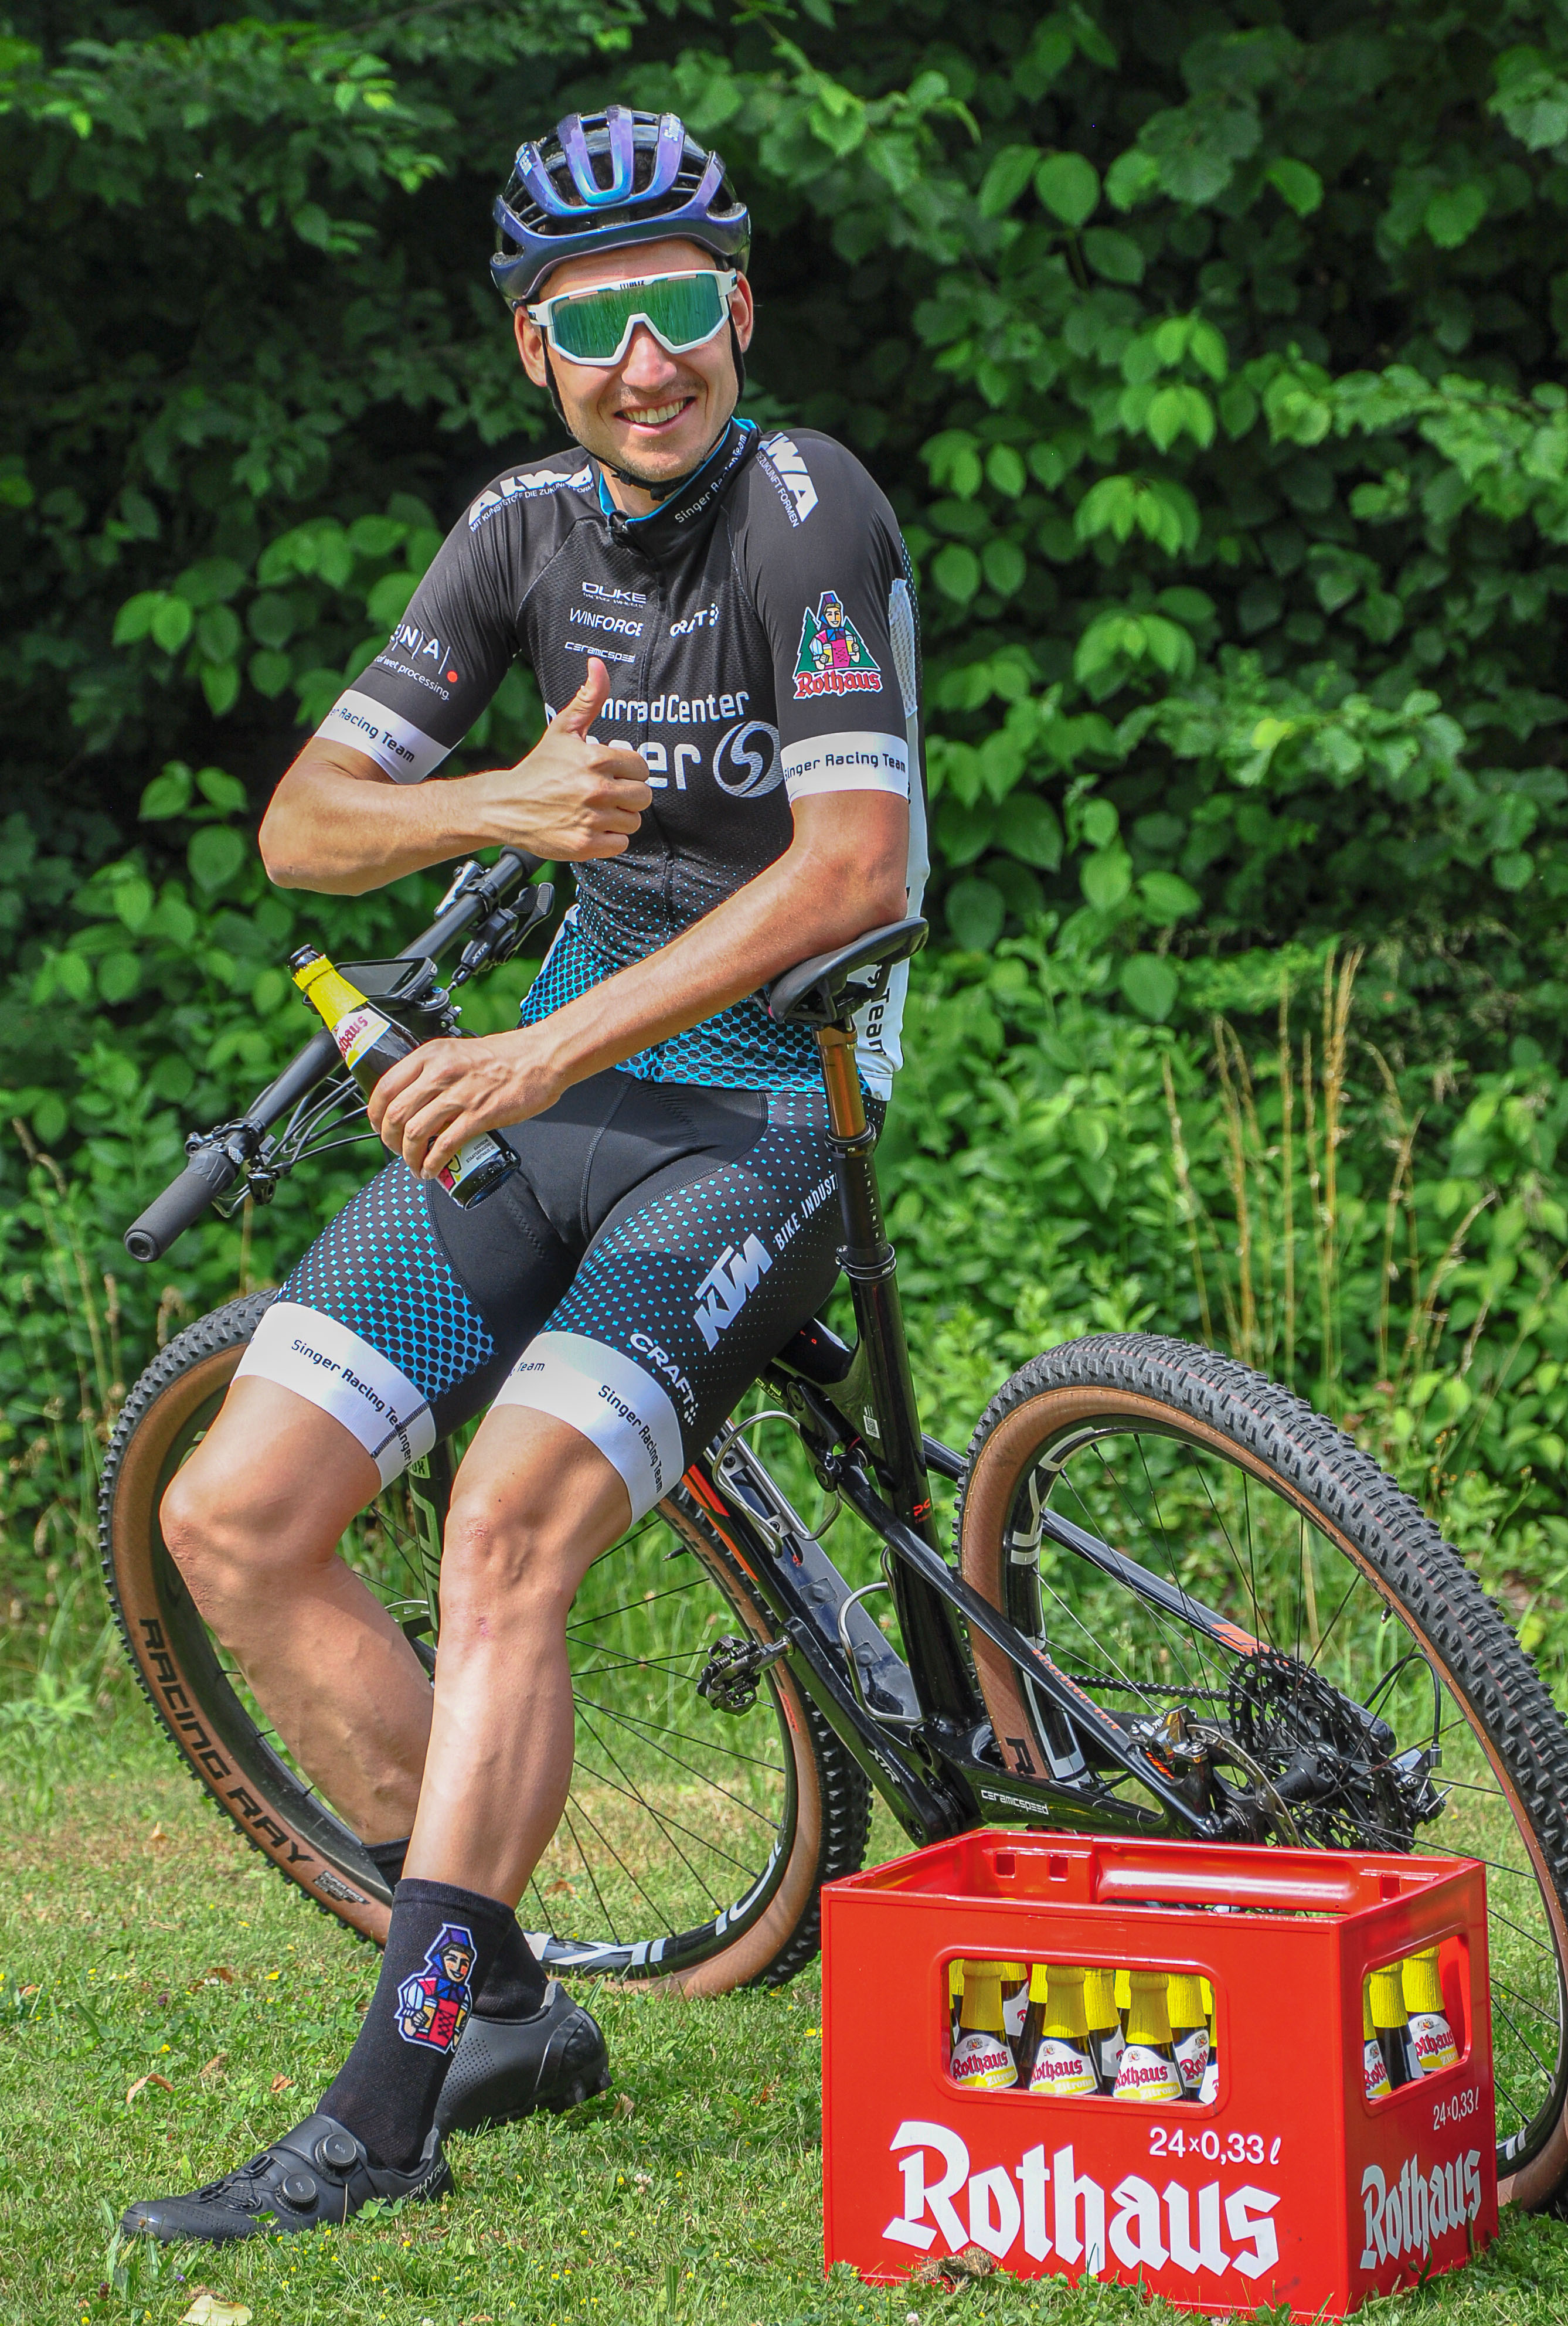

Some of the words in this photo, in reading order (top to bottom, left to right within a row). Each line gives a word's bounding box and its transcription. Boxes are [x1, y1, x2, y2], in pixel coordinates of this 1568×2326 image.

[675, 491, 711, 523] Singer
[732, 434, 747, 456] Team
[759, 454, 783, 489] ZUKUNFT
[777, 487, 800, 528] FORMEN
[470, 518, 482, 533] MIT
[482, 491, 524, 522] KUNSTSTOFF
[525, 490, 538, 499] DIE
[581, 581, 647, 604] DUKE
[569, 607, 644, 637] WINFORCE
[383, 657, 400, 669] wet
[795, 669, 882, 698] Rothaus
[338, 708, 379, 739] Racing
[382, 731, 415, 763] Team
[825, 751, 879, 768] Racing
[882, 753, 906, 774] Team
[774, 1212, 801, 1252] BIKE
[800, 1172, 838, 1219] INDUST
[693, 1233, 773, 1352] KTM
[291, 1339, 341, 1372] Singer
[341, 1368, 386, 1413] Racing
[517, 1362, 546, 1372] Team
[629, 1332, 696, 1405] CRAFT
[598, 1384, 642, 1427] Singer
[638, 1424, 658, 1467] Racing
[652, 1460, 664, 1494] Team
[1032, 1648, 1093, 1704] INDUSTRIES
[138, 1618, 232, 1781] RACING
[226, 1786, 314, 1865] RAY
[1094, 1708, 1120, 1730] BIKE
[867, 1747, 901, 1784] XTR
[981, 1790, 1049, 1815] ceramicspeed
[953, 2050, 1008, 2080] Rothaus
[881, 2120, 1281, 2281] Rothaus
[1359, 2149, 1482, 2270] Rothaus
